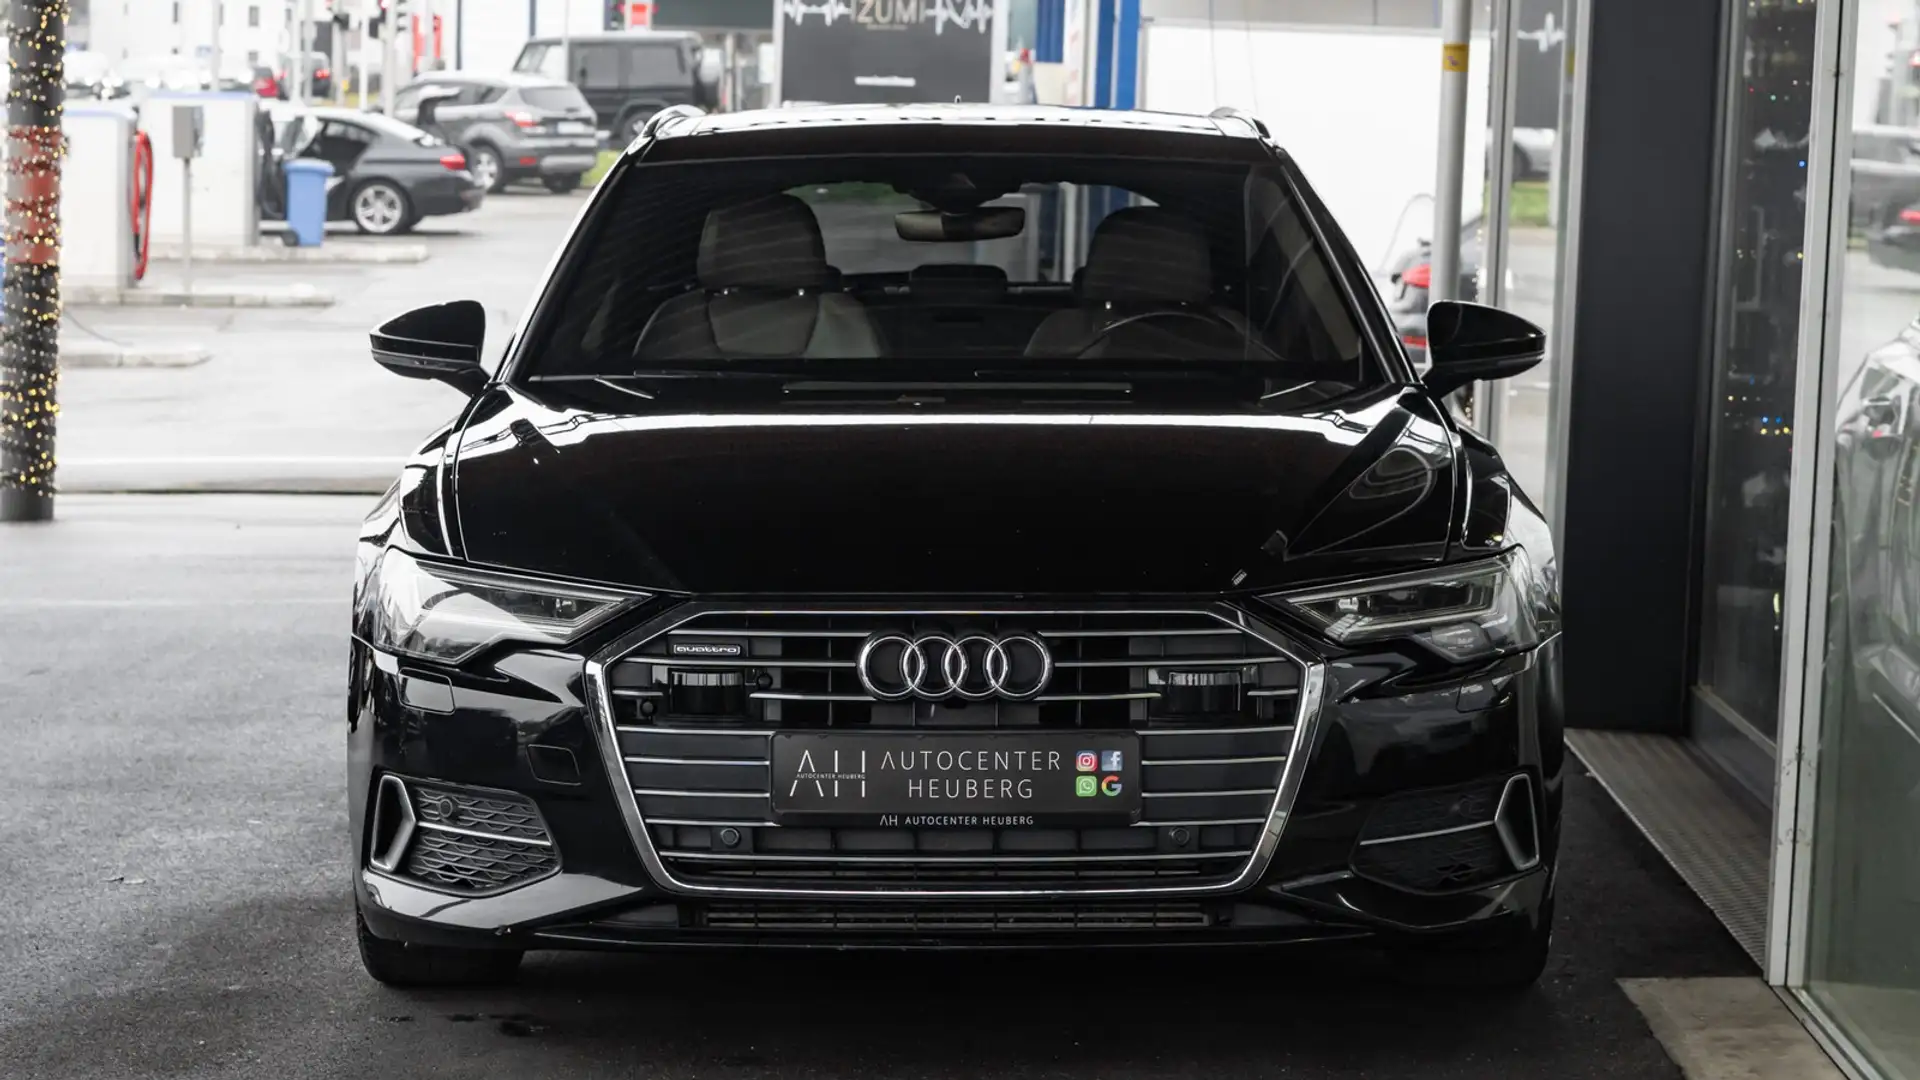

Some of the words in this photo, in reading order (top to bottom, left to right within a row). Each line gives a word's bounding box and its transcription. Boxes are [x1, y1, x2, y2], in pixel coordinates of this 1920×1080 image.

[676, 645, 737, 653] quattro
[880, 750, 1061, 771] AUTOCENTER
[908, 778, 1033, 799] HEUBERG
[879, 815, 898, 827] AH
[904, 815, 978, 826] AUTOCENTER
[982, 815, 1034, 826] HEUBERG
